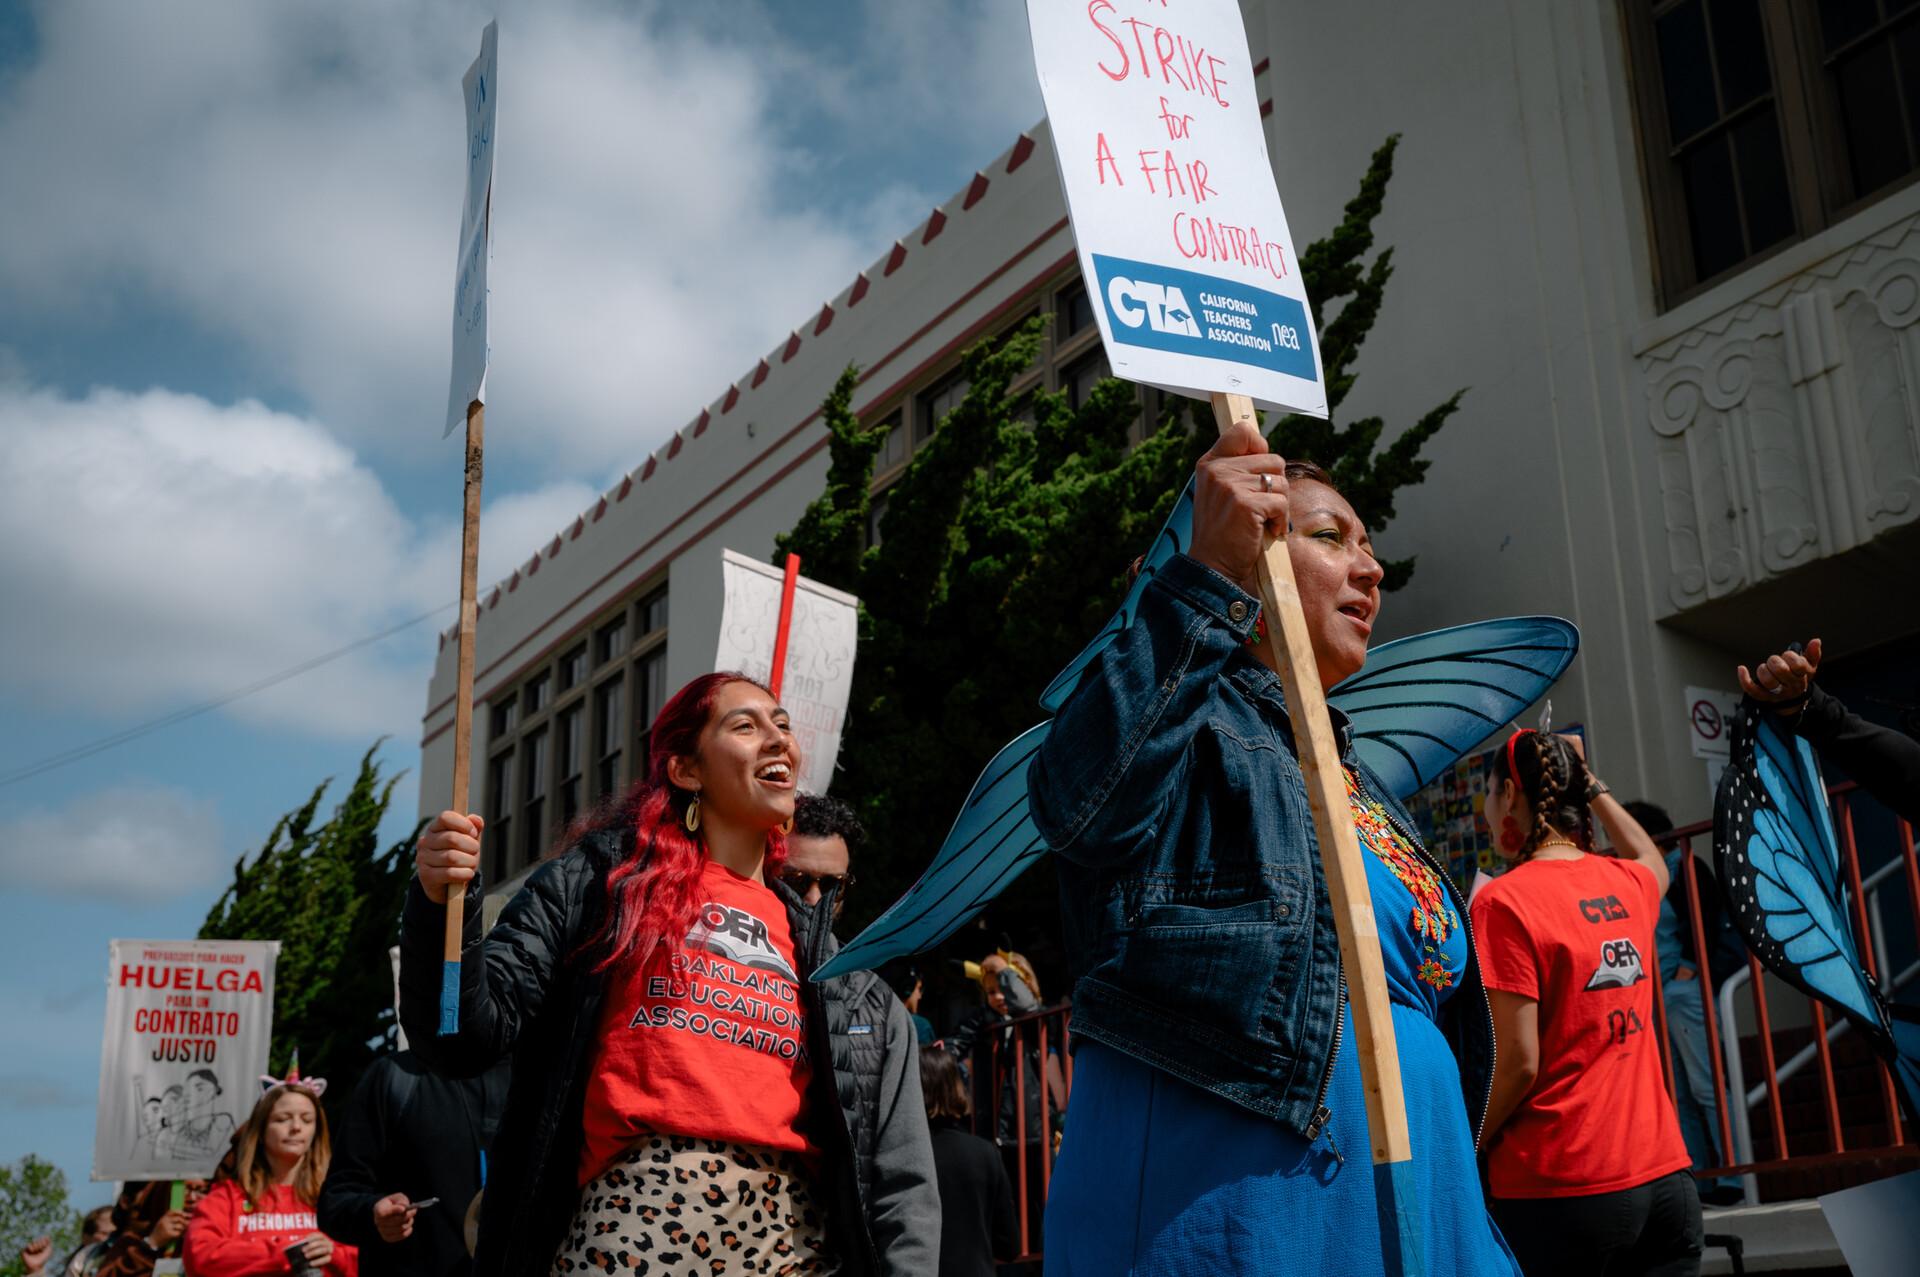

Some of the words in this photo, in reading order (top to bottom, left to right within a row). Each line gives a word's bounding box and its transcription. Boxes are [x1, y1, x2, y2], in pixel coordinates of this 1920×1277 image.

[1088, 0, 1230, 108] STRIKE
[1158, 96, 1196, 141] for
[1095, 132, 1125, 187] A
[1138, 150, 1219, 205] FAIR
[1173, 212, 1289, 280] CONTRACT
[1107, 276, 1203, 339] CTA
[1199, 291, 1259, 317] CALIFORNIA
[1202, 309, 1253, 332] TEACHERS
[1207, 327, 1272, 353] ASSOCIATION
[1271, 322, 1301, 351] nea
[1579, 895, 1630, 924] CTA
[701, 902, 778, 957] OEA
[1601, 938, 1642, 969] OEA
[119, 964, 264, 993] HUELGA
[670, 952, 795, 1003] OAKLAND
[166, 995, 192, 1008] PARA
[648, 976, 805, 1036] EDUCATION
[135, 1009, 239, 1037] CONTRATO
[629, 1005, 811, 1065] ASSOCIATION
[152, 1038, 216, 1064] JUSTO
